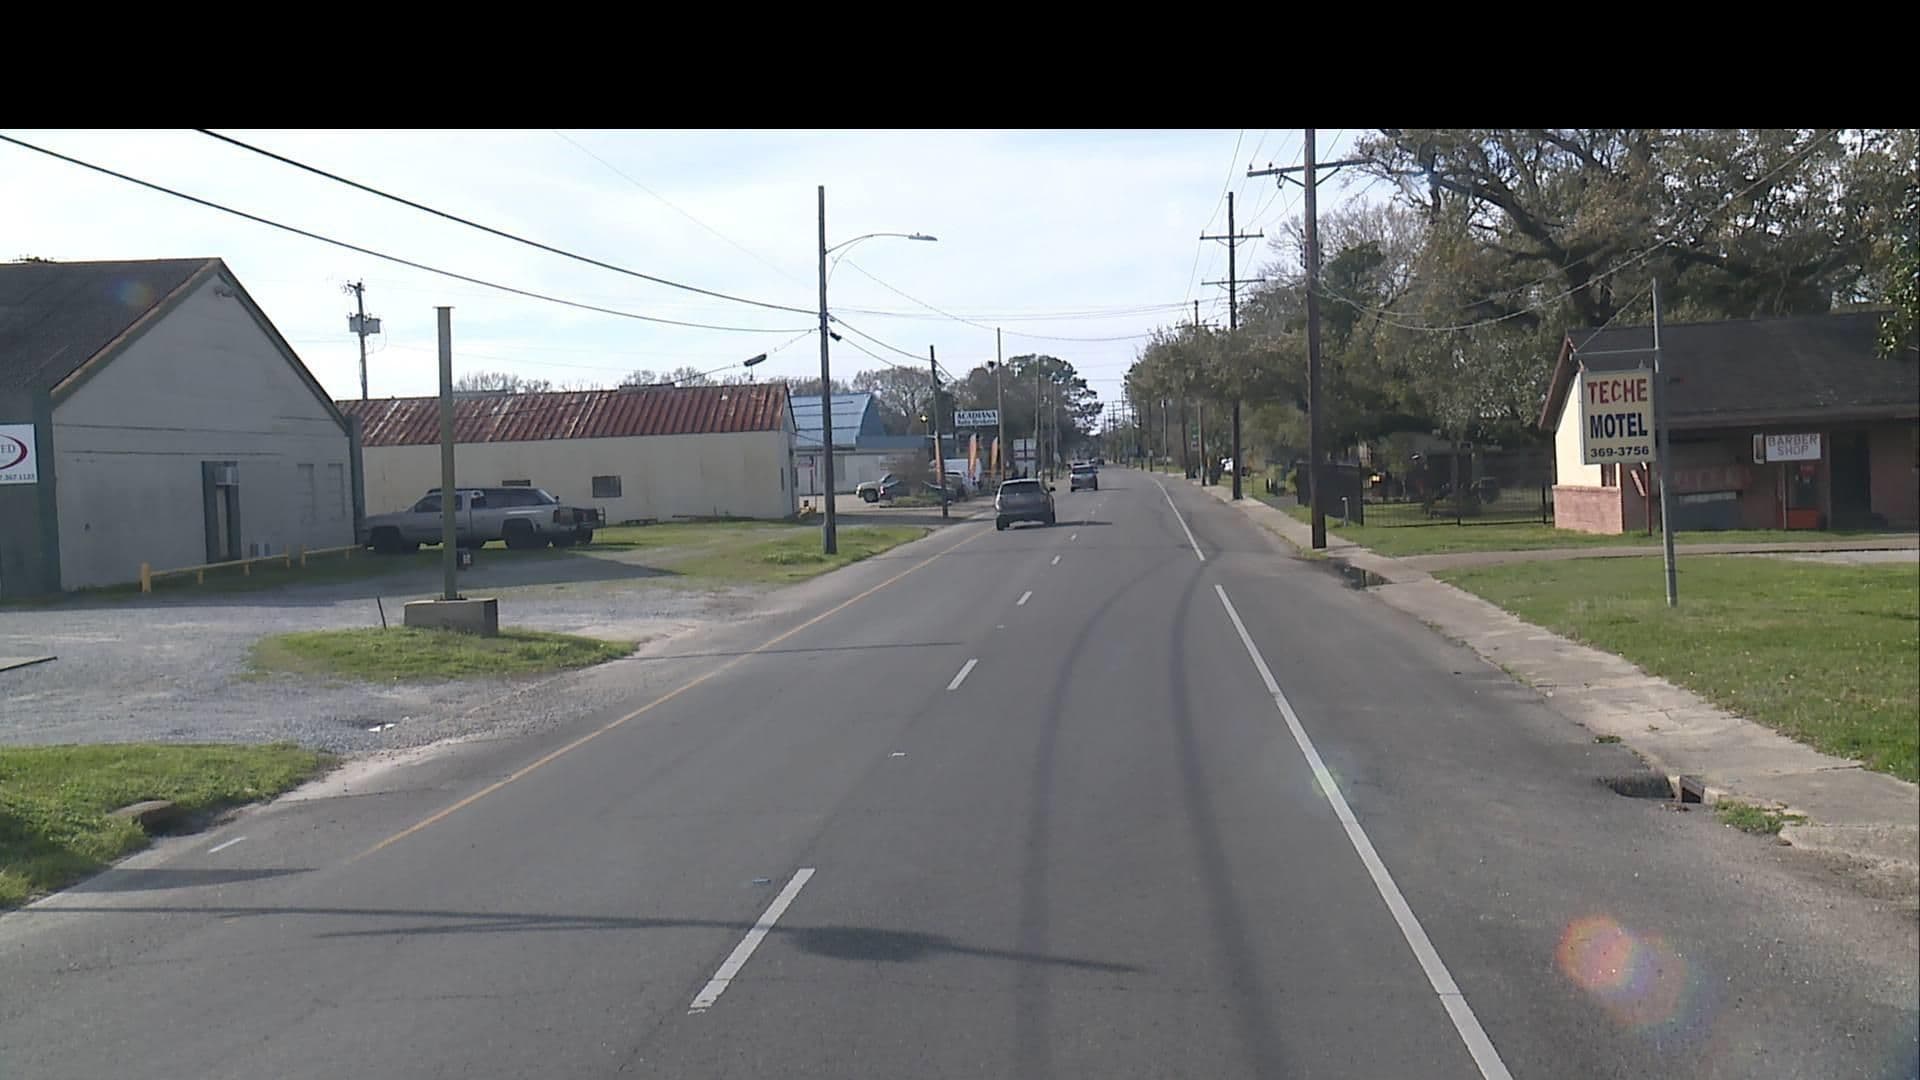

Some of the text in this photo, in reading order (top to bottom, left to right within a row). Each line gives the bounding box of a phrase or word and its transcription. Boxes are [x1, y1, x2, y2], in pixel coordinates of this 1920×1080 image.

[1587, 379, 1648, 405] TECHE
[957, 411, 996, 419] ACADIANA
[1590, 412, 1648, 439] MOTEL
[1767, 433, 1817, 447] BARBER
[1591, 446, 1649, 457] 369-3756
[1777, 446, 1809, 456] SHOP
